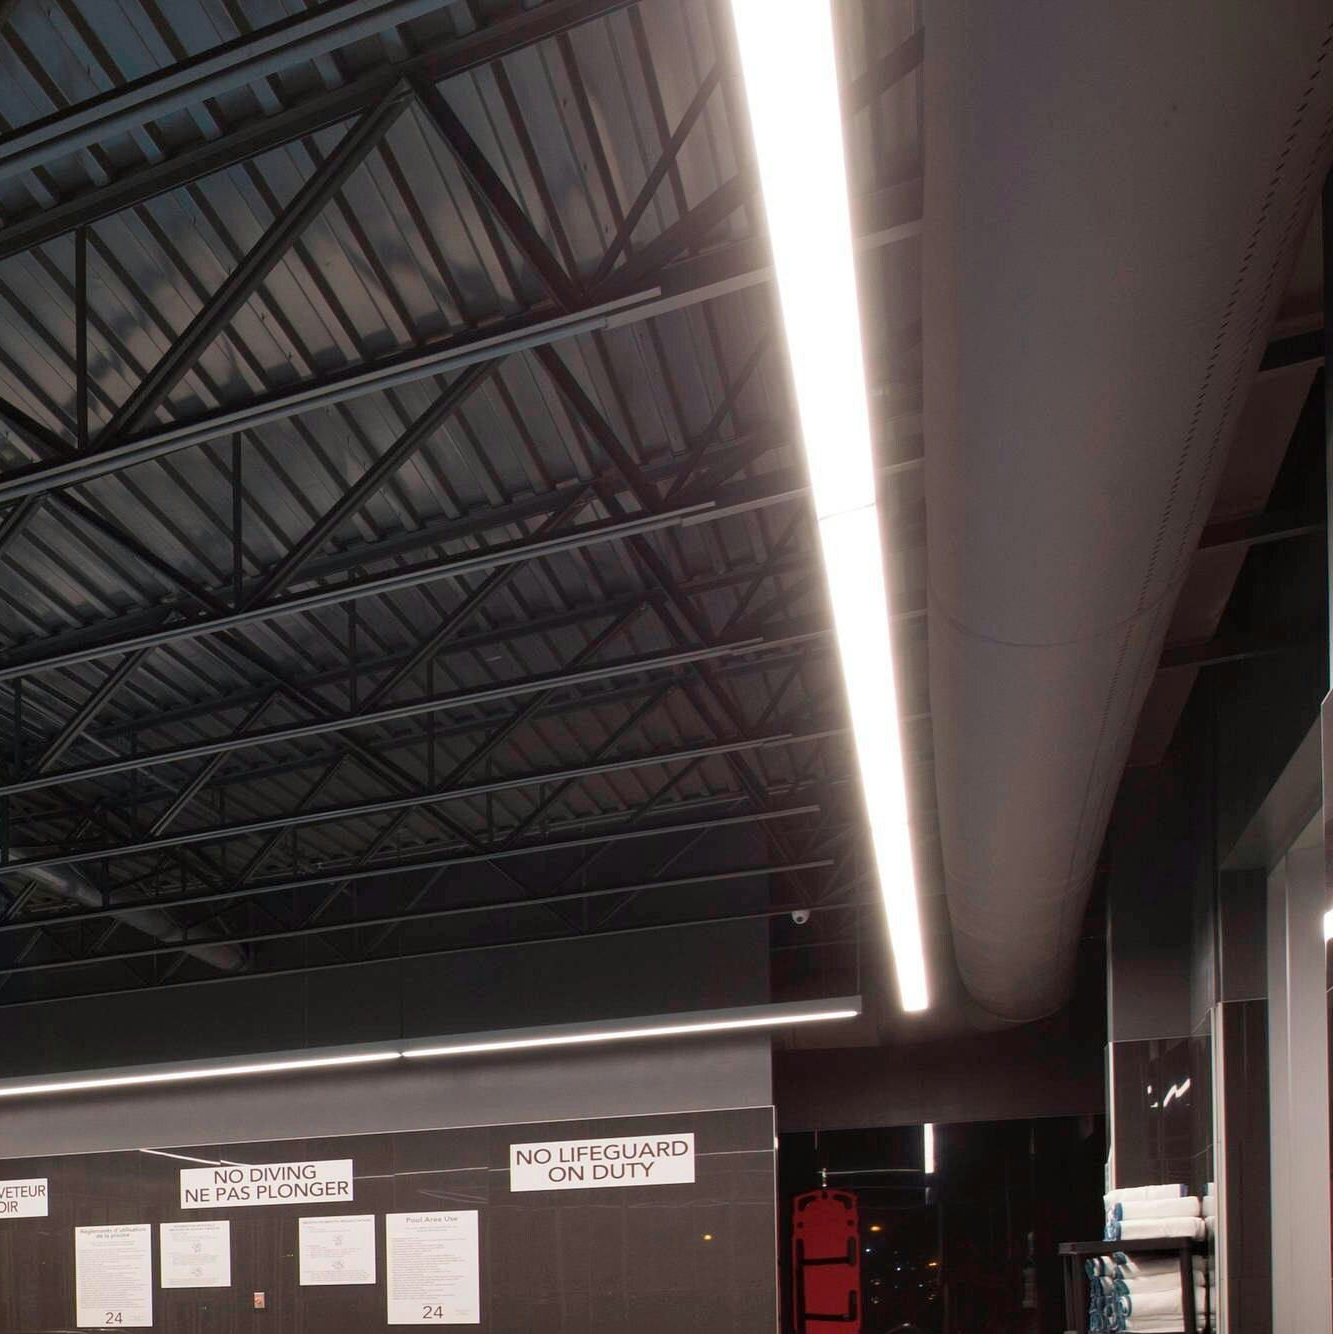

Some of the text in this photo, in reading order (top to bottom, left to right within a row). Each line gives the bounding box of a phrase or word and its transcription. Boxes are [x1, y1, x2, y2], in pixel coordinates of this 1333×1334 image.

[516, 1140, 689, 1165] NO LIFEGUARD
[214, 1165, 317, 1184] NO DIVING
[548, 1161, 655, 1182] ON DUTY
[185, 1181, 349, 1203] NE PAS PLONGER
[405, 1216, 423, 1224] Pool
[105, 1312, 123, 1325] 24
[422, 1305, 444, 1319] 24
